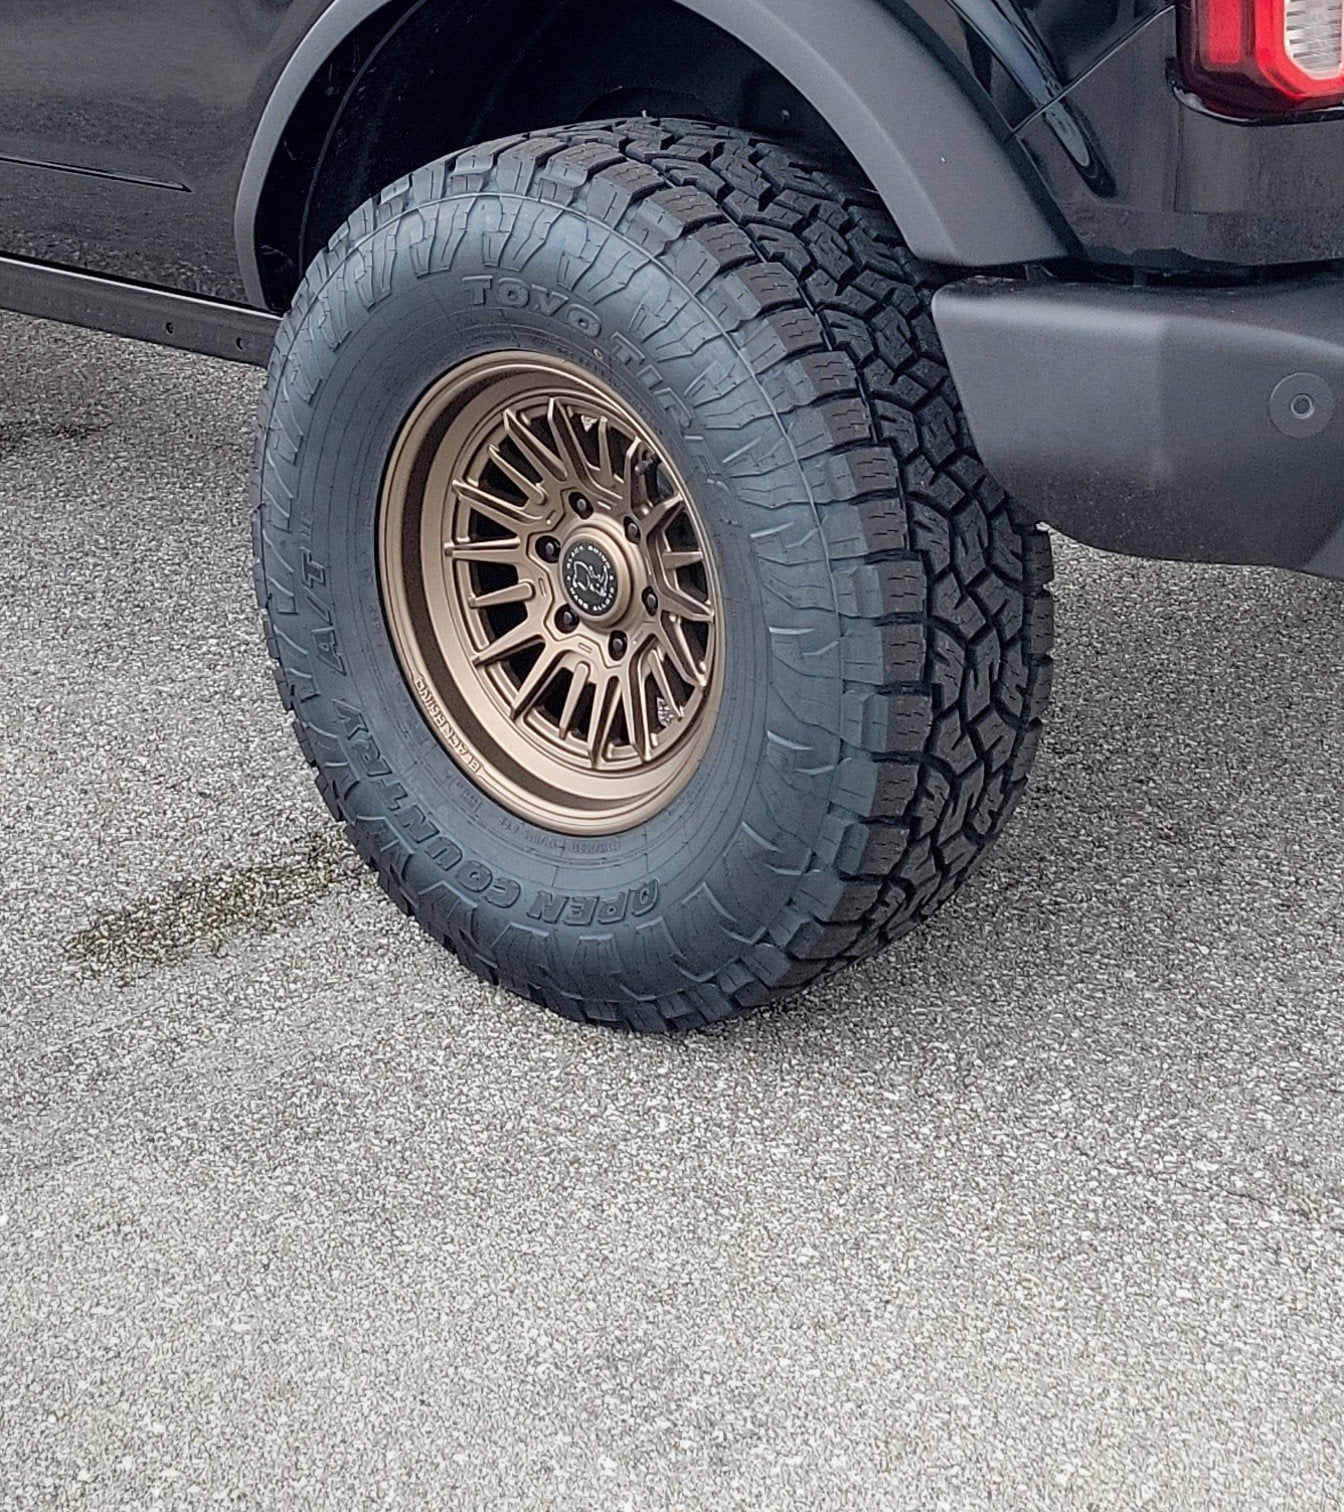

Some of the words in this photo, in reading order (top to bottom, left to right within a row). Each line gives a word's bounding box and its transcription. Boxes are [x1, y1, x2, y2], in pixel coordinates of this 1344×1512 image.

[462, 275, 602, 337] TOYO
[331, 698, 522, 908] COUNTRY
[526, 877, 659, 926] OPEN
